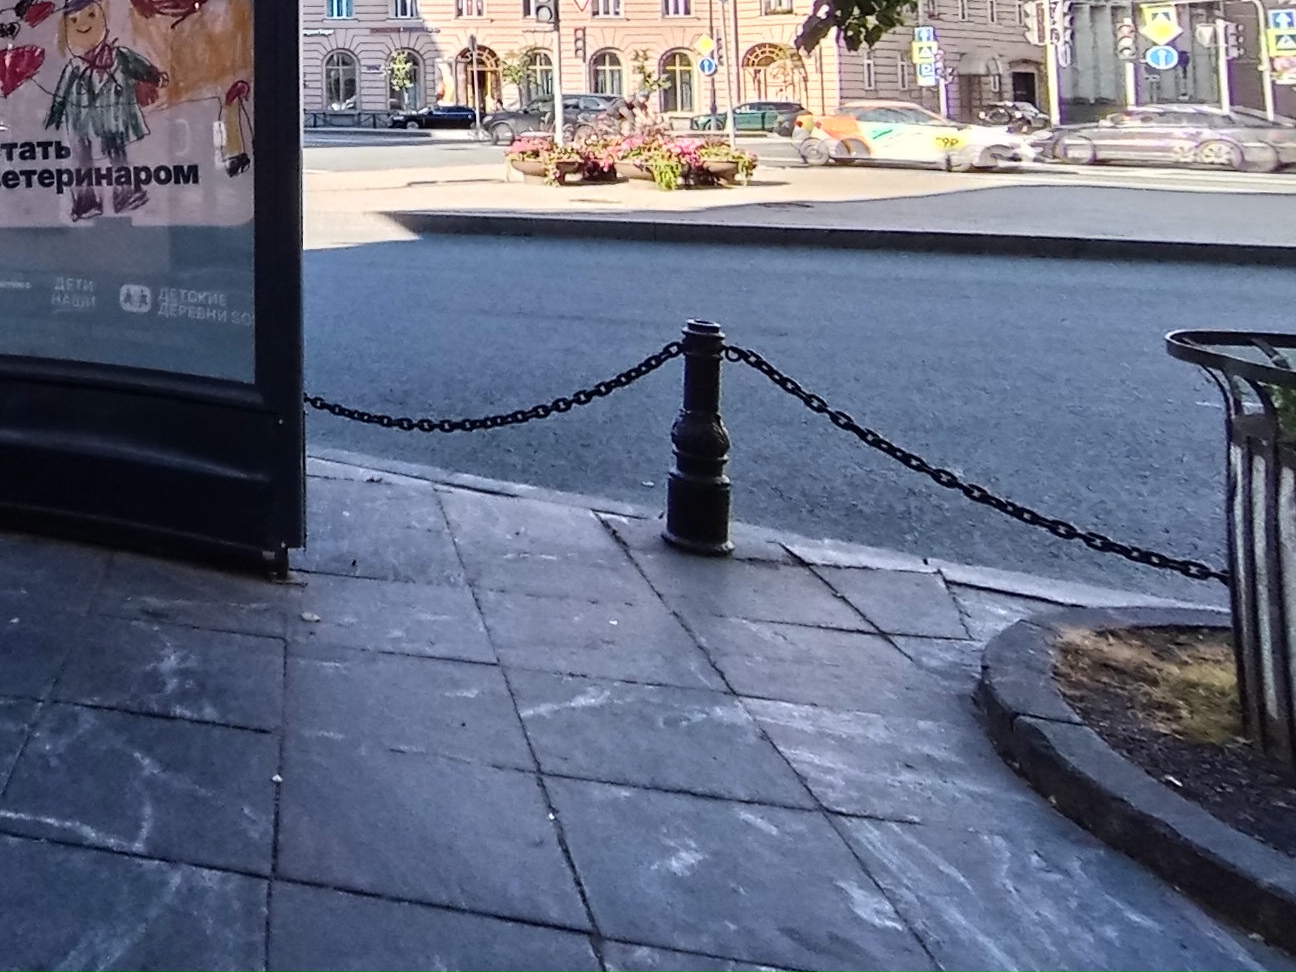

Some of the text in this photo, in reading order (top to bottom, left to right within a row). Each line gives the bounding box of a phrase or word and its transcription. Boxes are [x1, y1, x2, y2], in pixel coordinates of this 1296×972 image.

[54, 277, 94, 293] ДЕТИ
[157, 287, 228, 307] ДЕТСКИЕ
[157, 303, 254, 327] ДЕРЕВНИ SO
